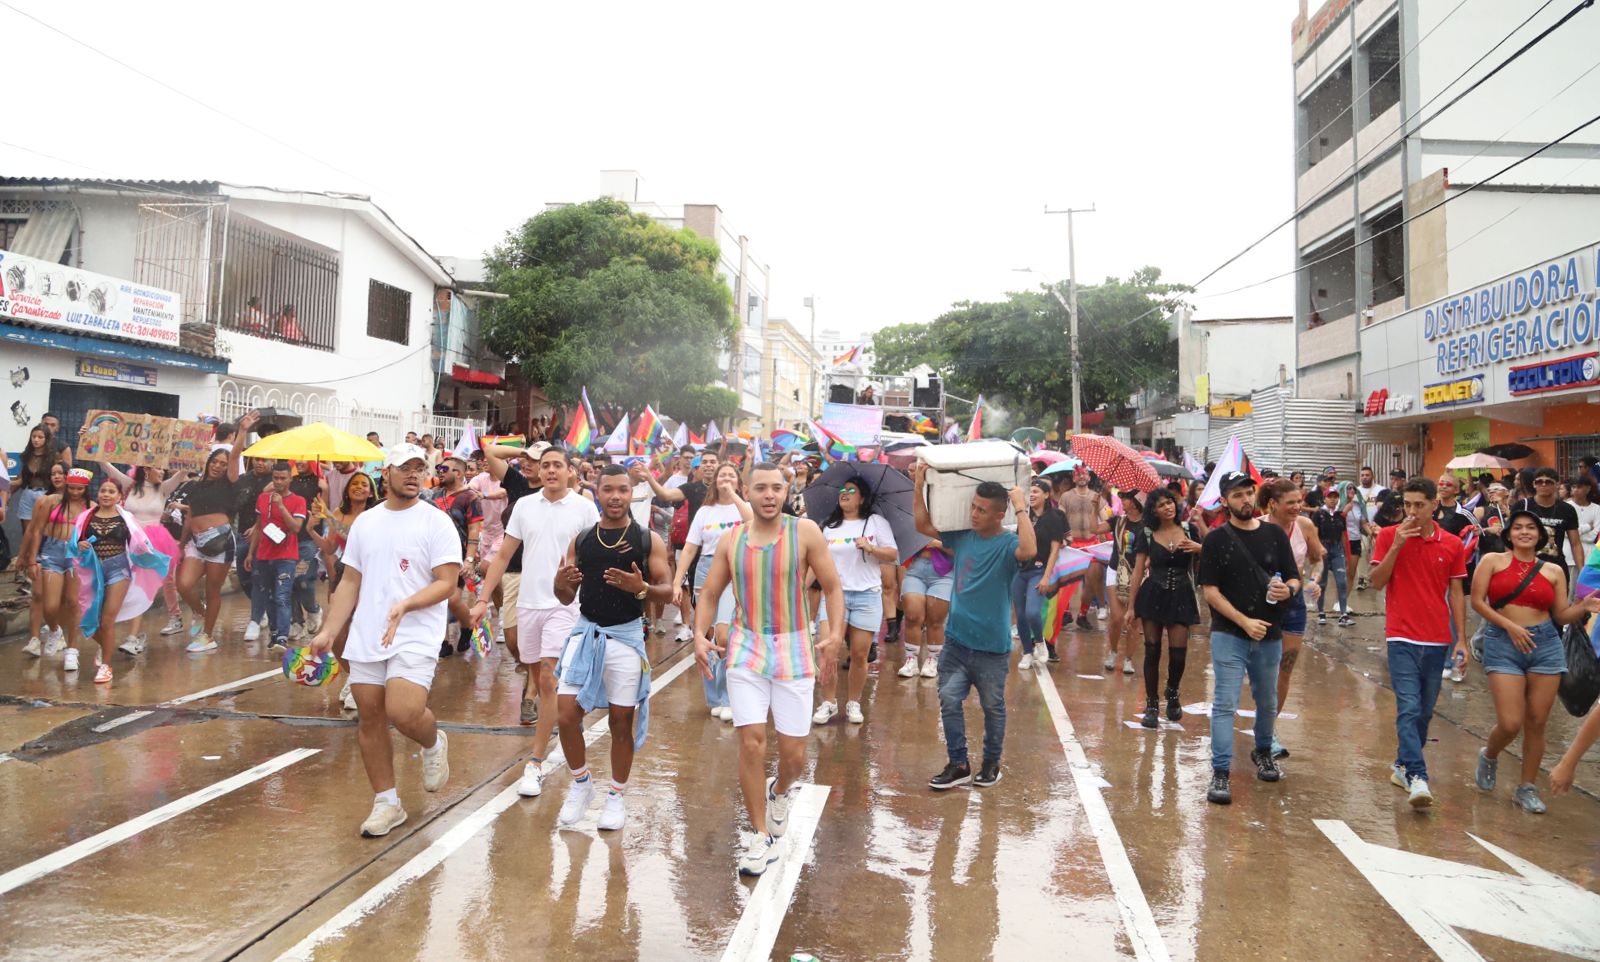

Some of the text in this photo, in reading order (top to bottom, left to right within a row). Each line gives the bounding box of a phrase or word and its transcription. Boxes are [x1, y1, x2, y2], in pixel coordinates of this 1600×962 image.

[1424, 257, 1579, 339] DISTRIBUIDORA
[66, 311, 82, 323] LUIS
[83, 314, 120, 330] ZABALETA
[133, 306, 174, 320] MANTENIMIENTO
